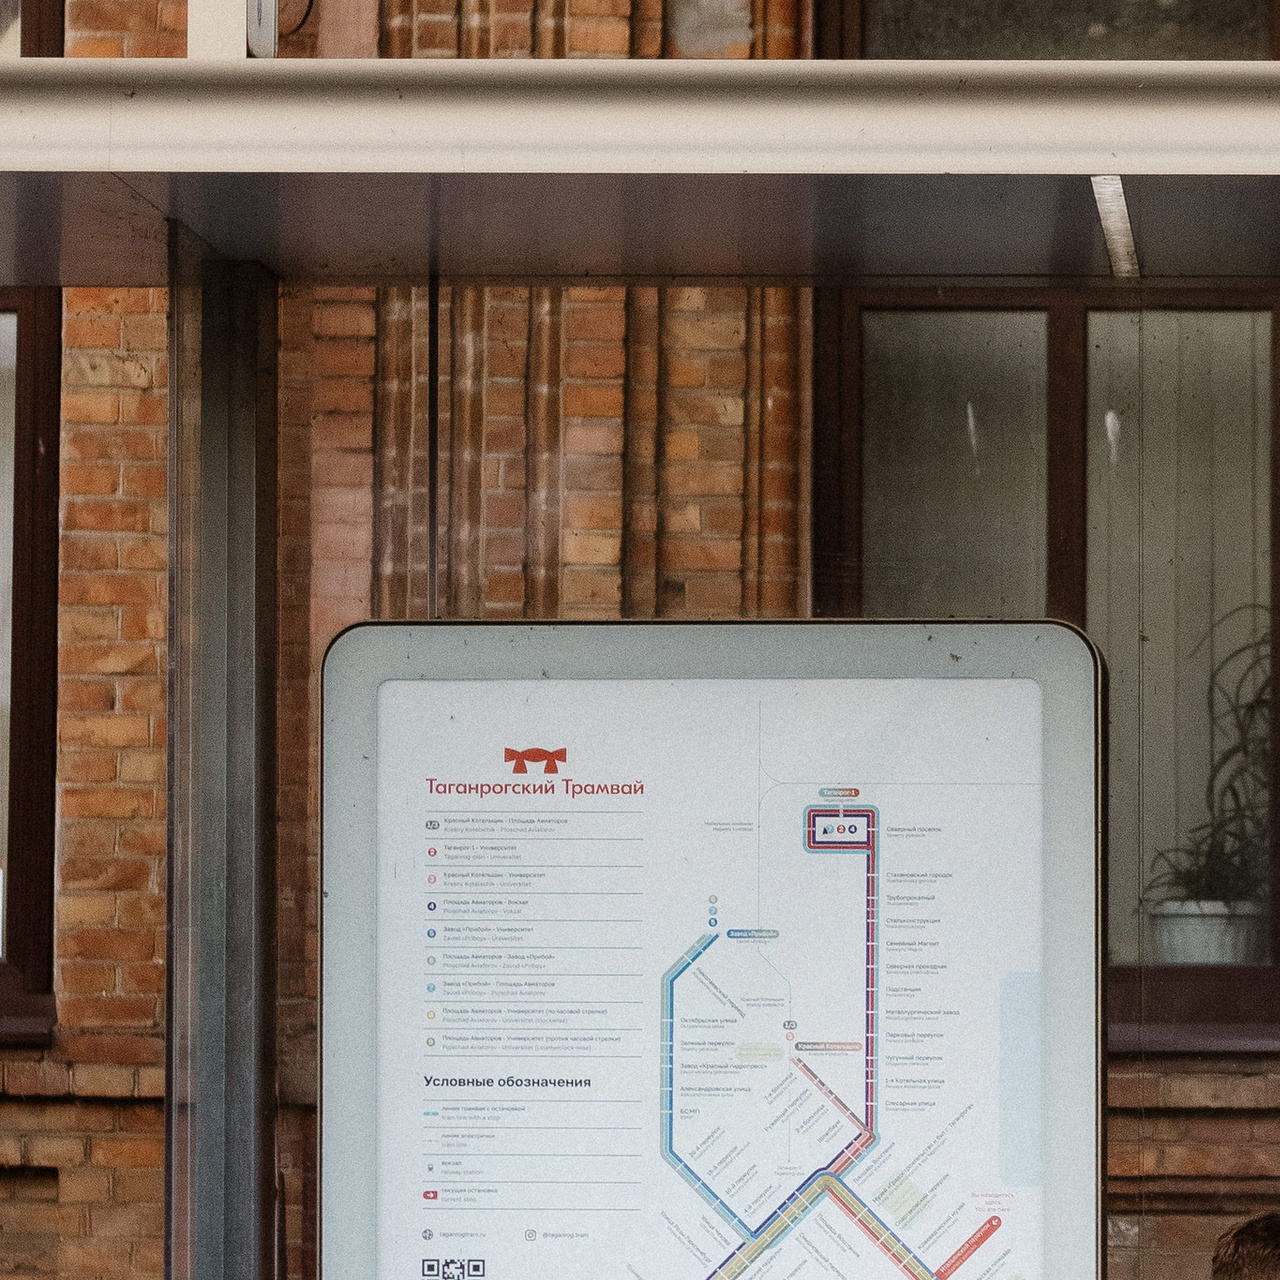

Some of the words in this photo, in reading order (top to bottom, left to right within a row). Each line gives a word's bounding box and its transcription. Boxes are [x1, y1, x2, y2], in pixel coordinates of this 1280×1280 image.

[426, 778, 555, 798] Таганрогский
[562, 778, 644, 798] Трамвай
[423, 1076, 494, 1088] Условные
[498, 1076, 591, 1088] обозначения
